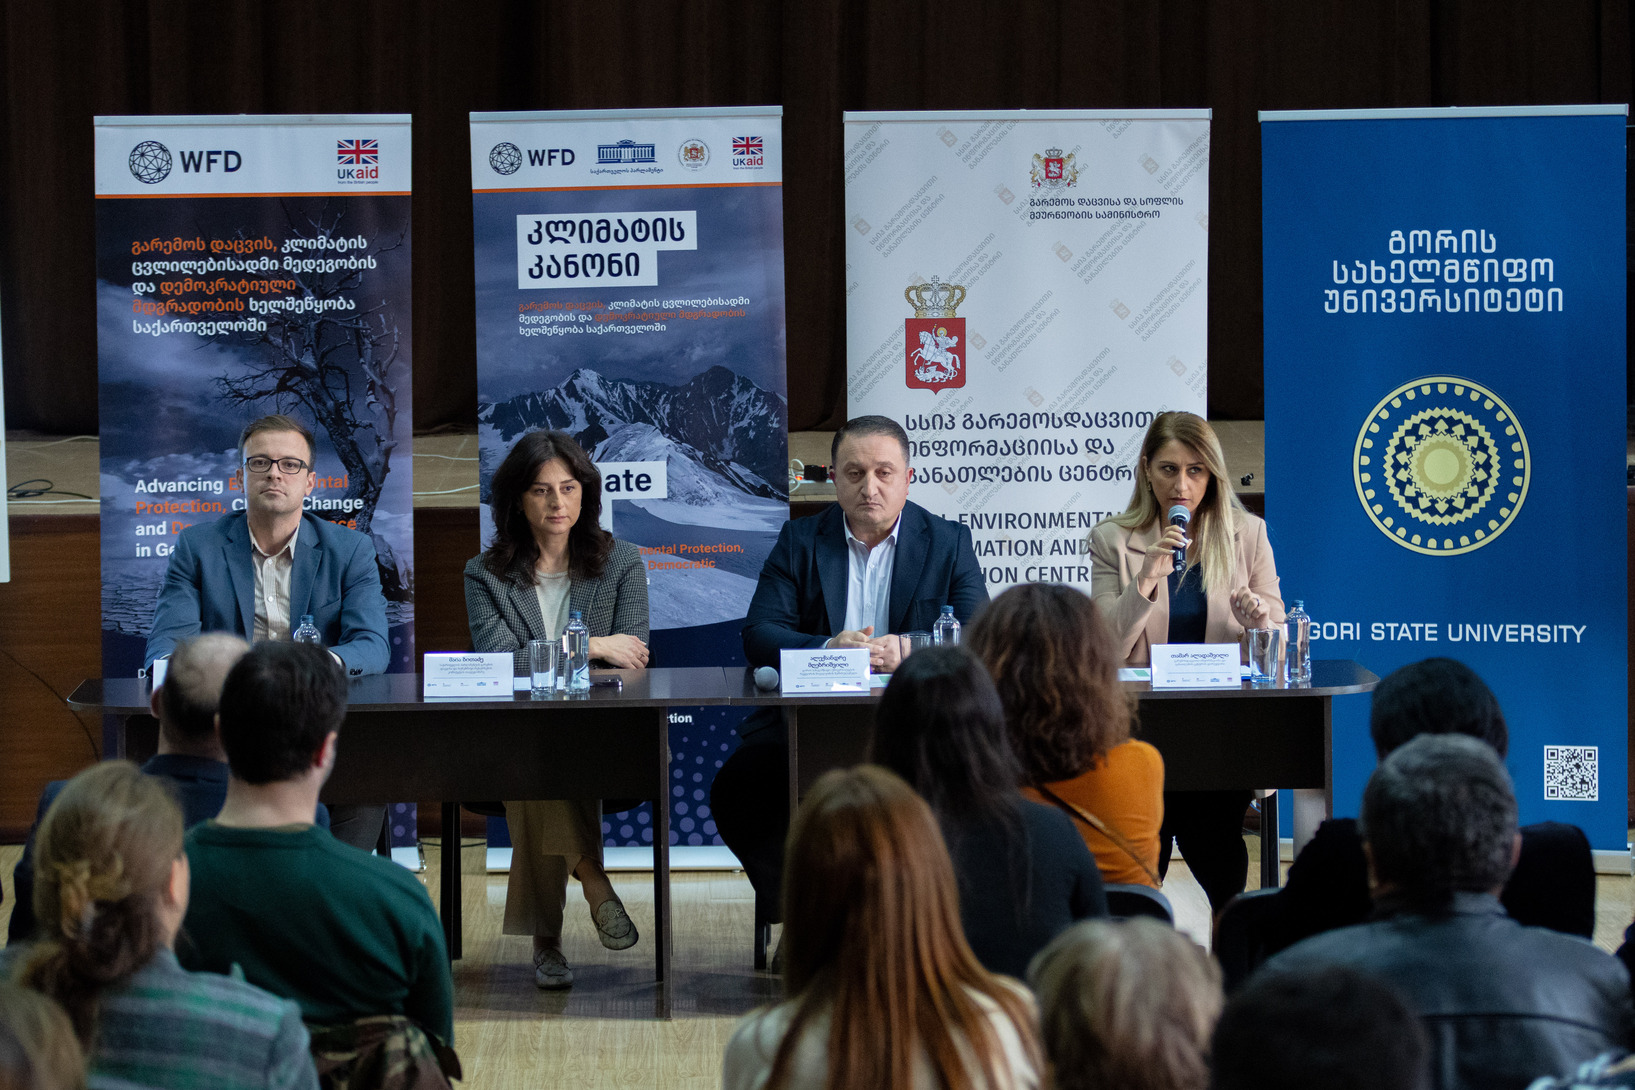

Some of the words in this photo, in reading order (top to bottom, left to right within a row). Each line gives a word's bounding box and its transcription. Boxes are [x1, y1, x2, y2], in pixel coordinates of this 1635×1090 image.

[180, 150, 242, 173] WFD
[527, 148, 575, 167] WFD
[1029, 198, 1075, 206] გარემოს
[1078, 198, 1121, 206] დაცვისა
[1124, 197, 1137, 206] და
[1140, 197, 1184, 206] სოფლის
[1029, 211, 1093, 220] მეურნეობის
[1095, 210, 1160, 219] სამინისტრო
[527, 217, 685, 245] კლიმატის
[132, 237, 205, 255] გარემოს
[210, 236, 277, 253] დაცვის,
[281, 235, 367, 253] კლიმატის
[1389, 229, 1496, 254] გორის
[132, 256, 278, 276] ცვლილებისადმი
[283, 255, 376, 273] მედეგობის
[528, 252, 640, 279] კანონი
[1332, 258, 1554, 284] სახელმწიფო
[132, 282, 155, 295] და
[160, 278, 296, 295] დემოკრატიული
[133, 298, 244, 316] მდგრადობის
[249, 296, 356, 315] ხელშეწყობა
[519, 301, 563, 312] გარემოს
[608, 299, 660, 310] კლიმატის
[662, 296, 750, 308] ცვლილებისადმი
[1324, 288, 1564, 314] უნივერსიტეტი
[519, 313, 576, 324] მედეგობის
[578, 314, 592, 323] და
[595, 311, 676, 322] დემოკრატიული
[678, 309, 746, 320] მდგრადობის
[133, 318, 267, 336] საქართველოში
[519, 325, 584, 337] ხელშეწყობა
[586, 323, 667, 335] საქართველოში
[905, 414, 956, 431] სსიპ
[1085, 438, 1115, 454] და
[1059, 465, 1137, 482] ცენტრ
[135, 478, 223, 494] Advancing
[136, 499, 226, 514] Protection,
[302, 496, 364, 513] Change
[135, 521, 167, 536] and
[958, 512, 1122, 529] ENVIRONMENT
[136, 543, 150, 557] in
[680, 542, 744, 554] Protection,
[973, 539, 1042, 556] MATION
[1050, 539, 1090, 556] AND
[648, 558, 716, 570] Democratic
[1025, 566, 1090, 583] CENTR
[1308, 622, 1360, 641] GORI
[1371, 623, 1438, 641] STATE
[1448, 624, 1586, 643] UNIVERSITY
